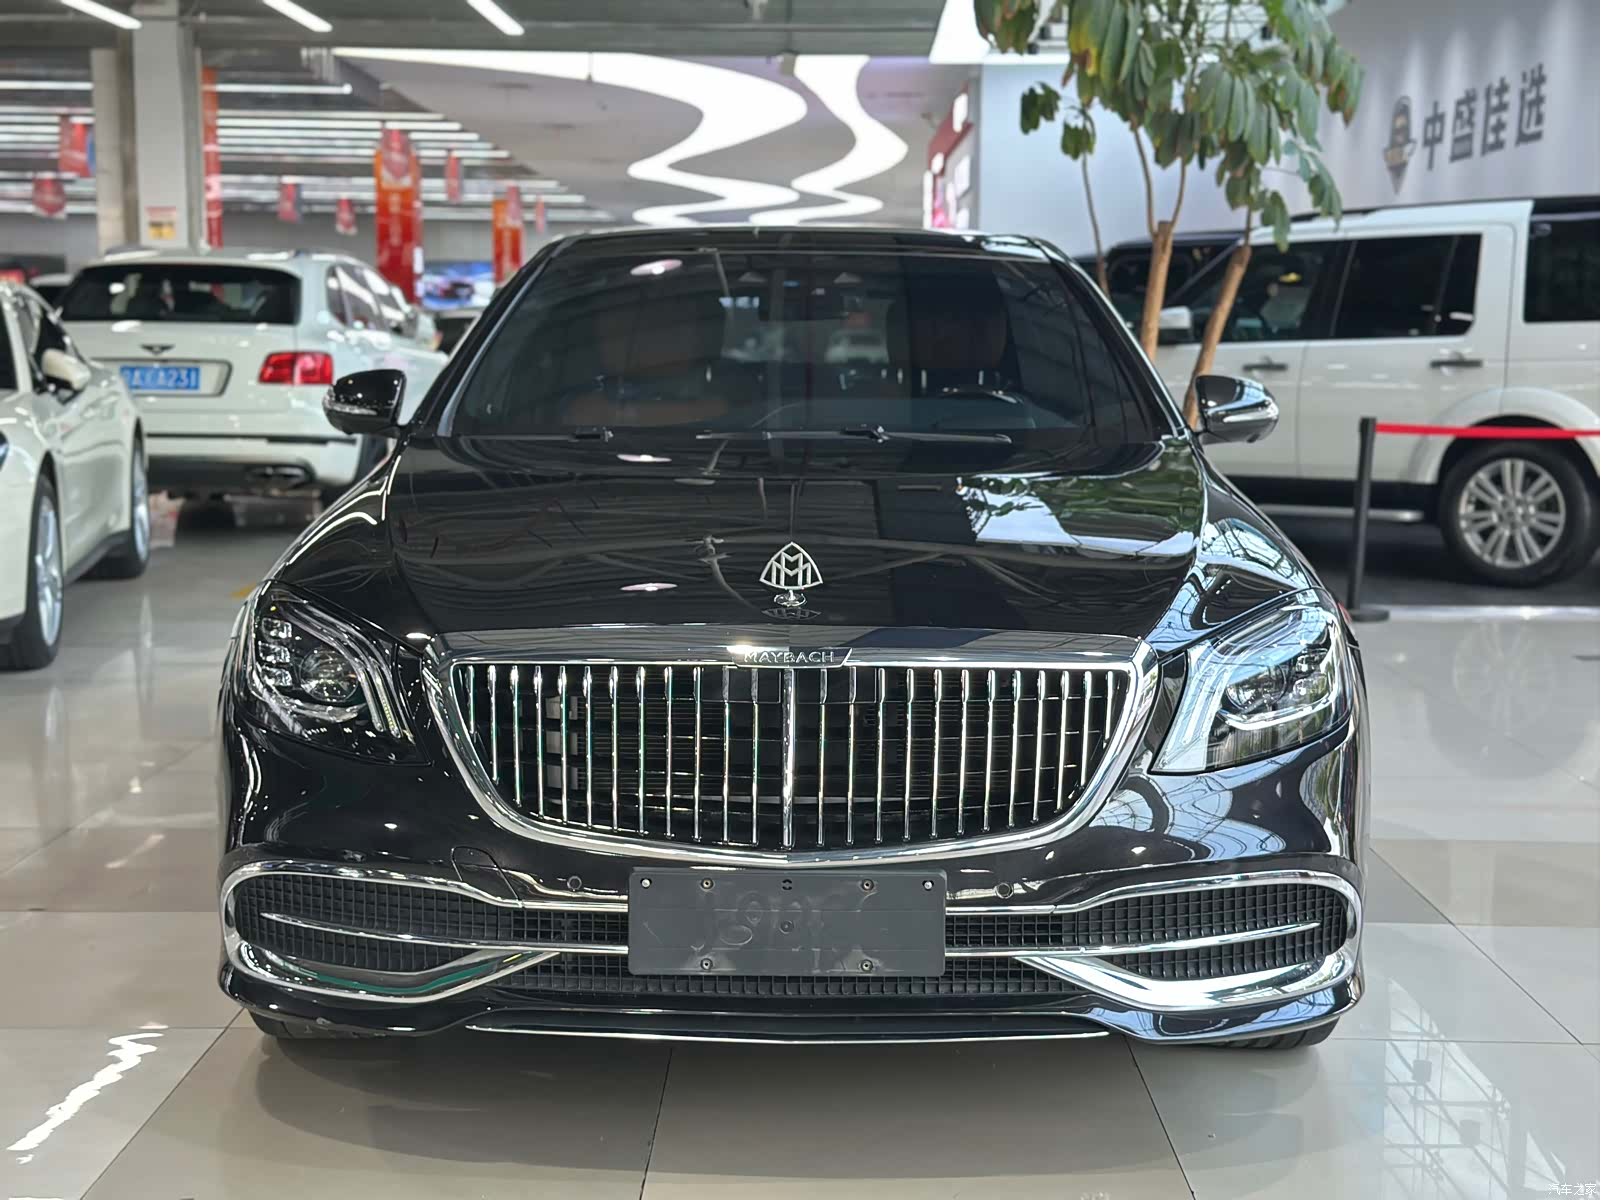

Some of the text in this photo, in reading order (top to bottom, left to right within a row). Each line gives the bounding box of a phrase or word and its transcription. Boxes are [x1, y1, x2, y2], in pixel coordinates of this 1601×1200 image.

[1423, 63, 1547, 171] 中盛佳选
[743, 650, 835, 663] MAYBACH
